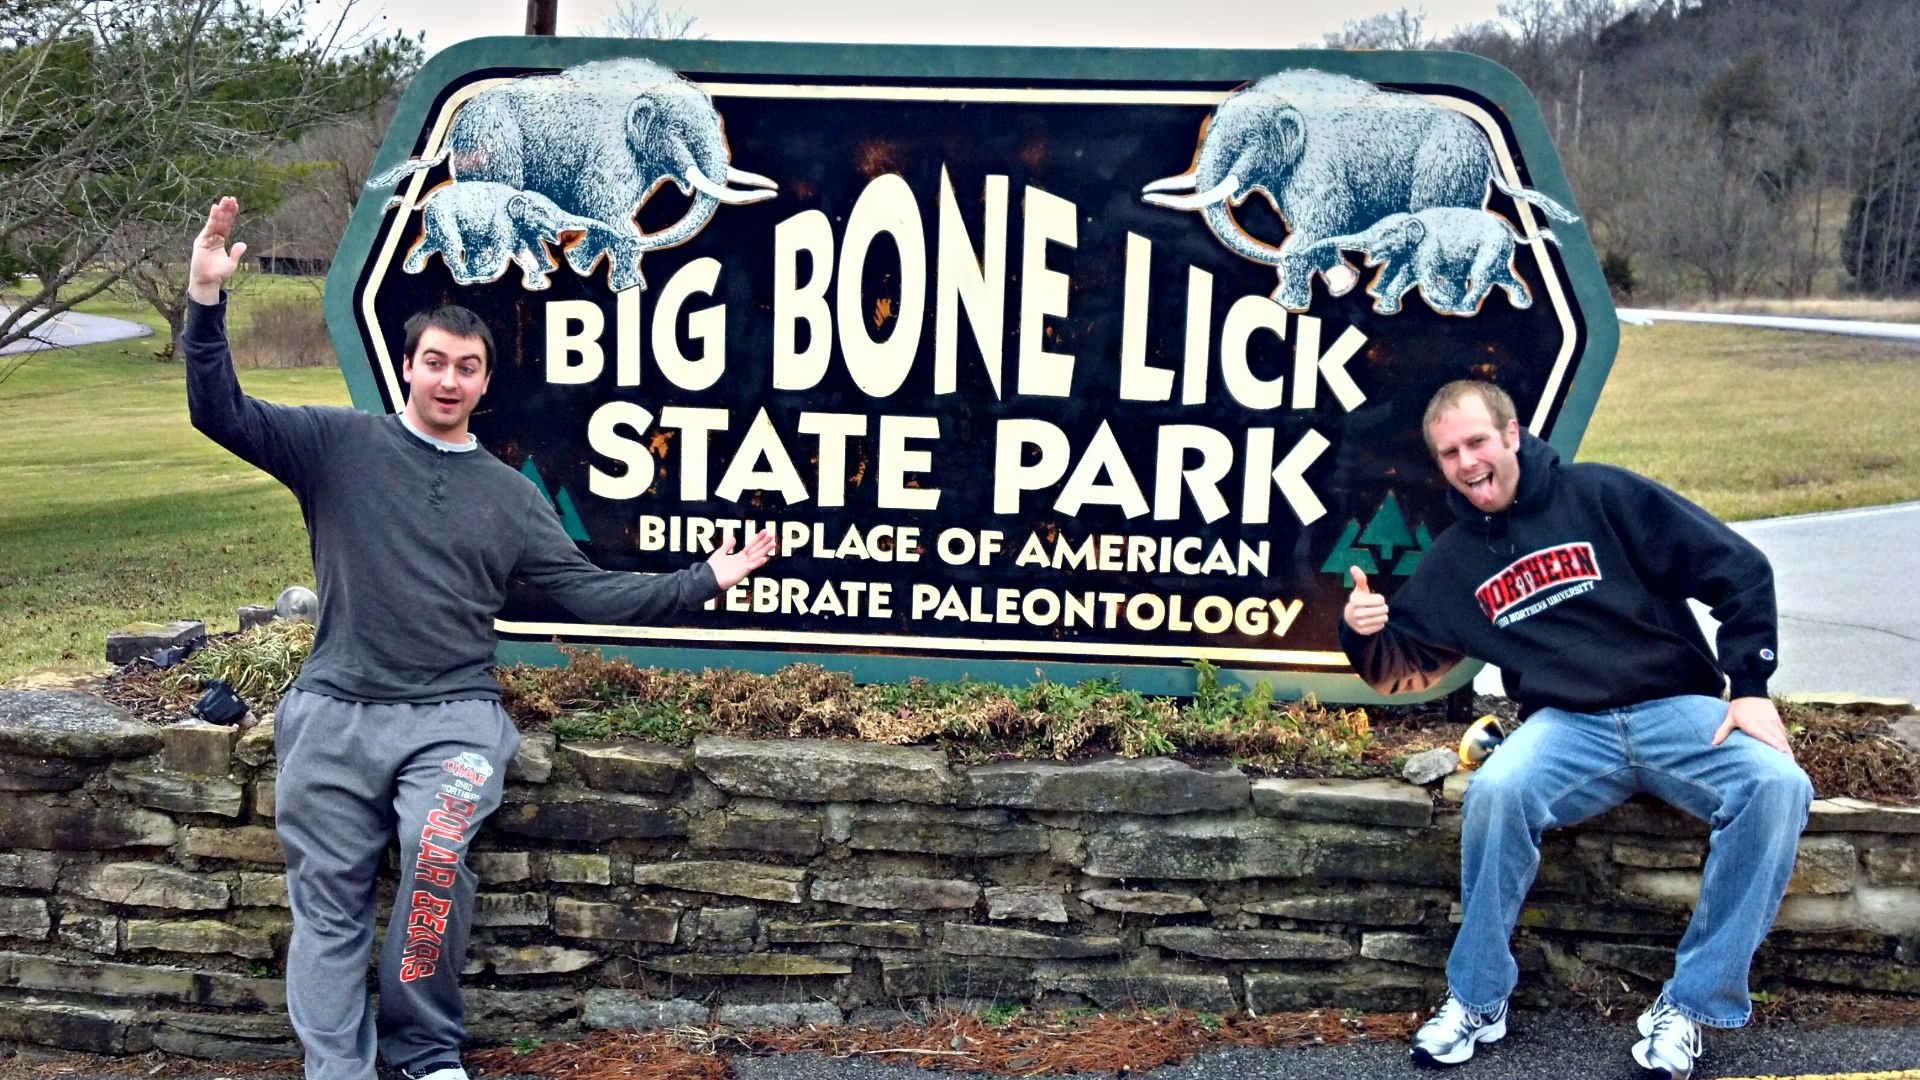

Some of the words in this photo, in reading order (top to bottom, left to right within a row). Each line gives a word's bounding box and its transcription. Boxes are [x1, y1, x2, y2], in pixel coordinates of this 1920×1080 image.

[545, 256, 726, 391] BIG
[773, 163, 1078, 400] BONE
[1119, 231, 1368, 412] LICK
[587, 400, 942, 510] STATE
[993, 418, 1331, 526] PARK
[639, 515, 921, 562] BIRTHPLACE
[937, 527, 1004, 566] OF
[1015, 531, 1270, 578] AMERICAN
[1475, 541, 1602, 625] NORTHERN
[606, 571, 893, 620] EBRATE
[911, 584, 1304, 637] PALEONTOLOGY
[1547, 580, 1595, 605] UNIVERSITY
[454, 779, 474, 793] OHIO
[415, 792, 478, 888] POLAR
[400, 890, 453, 982] BEARS
